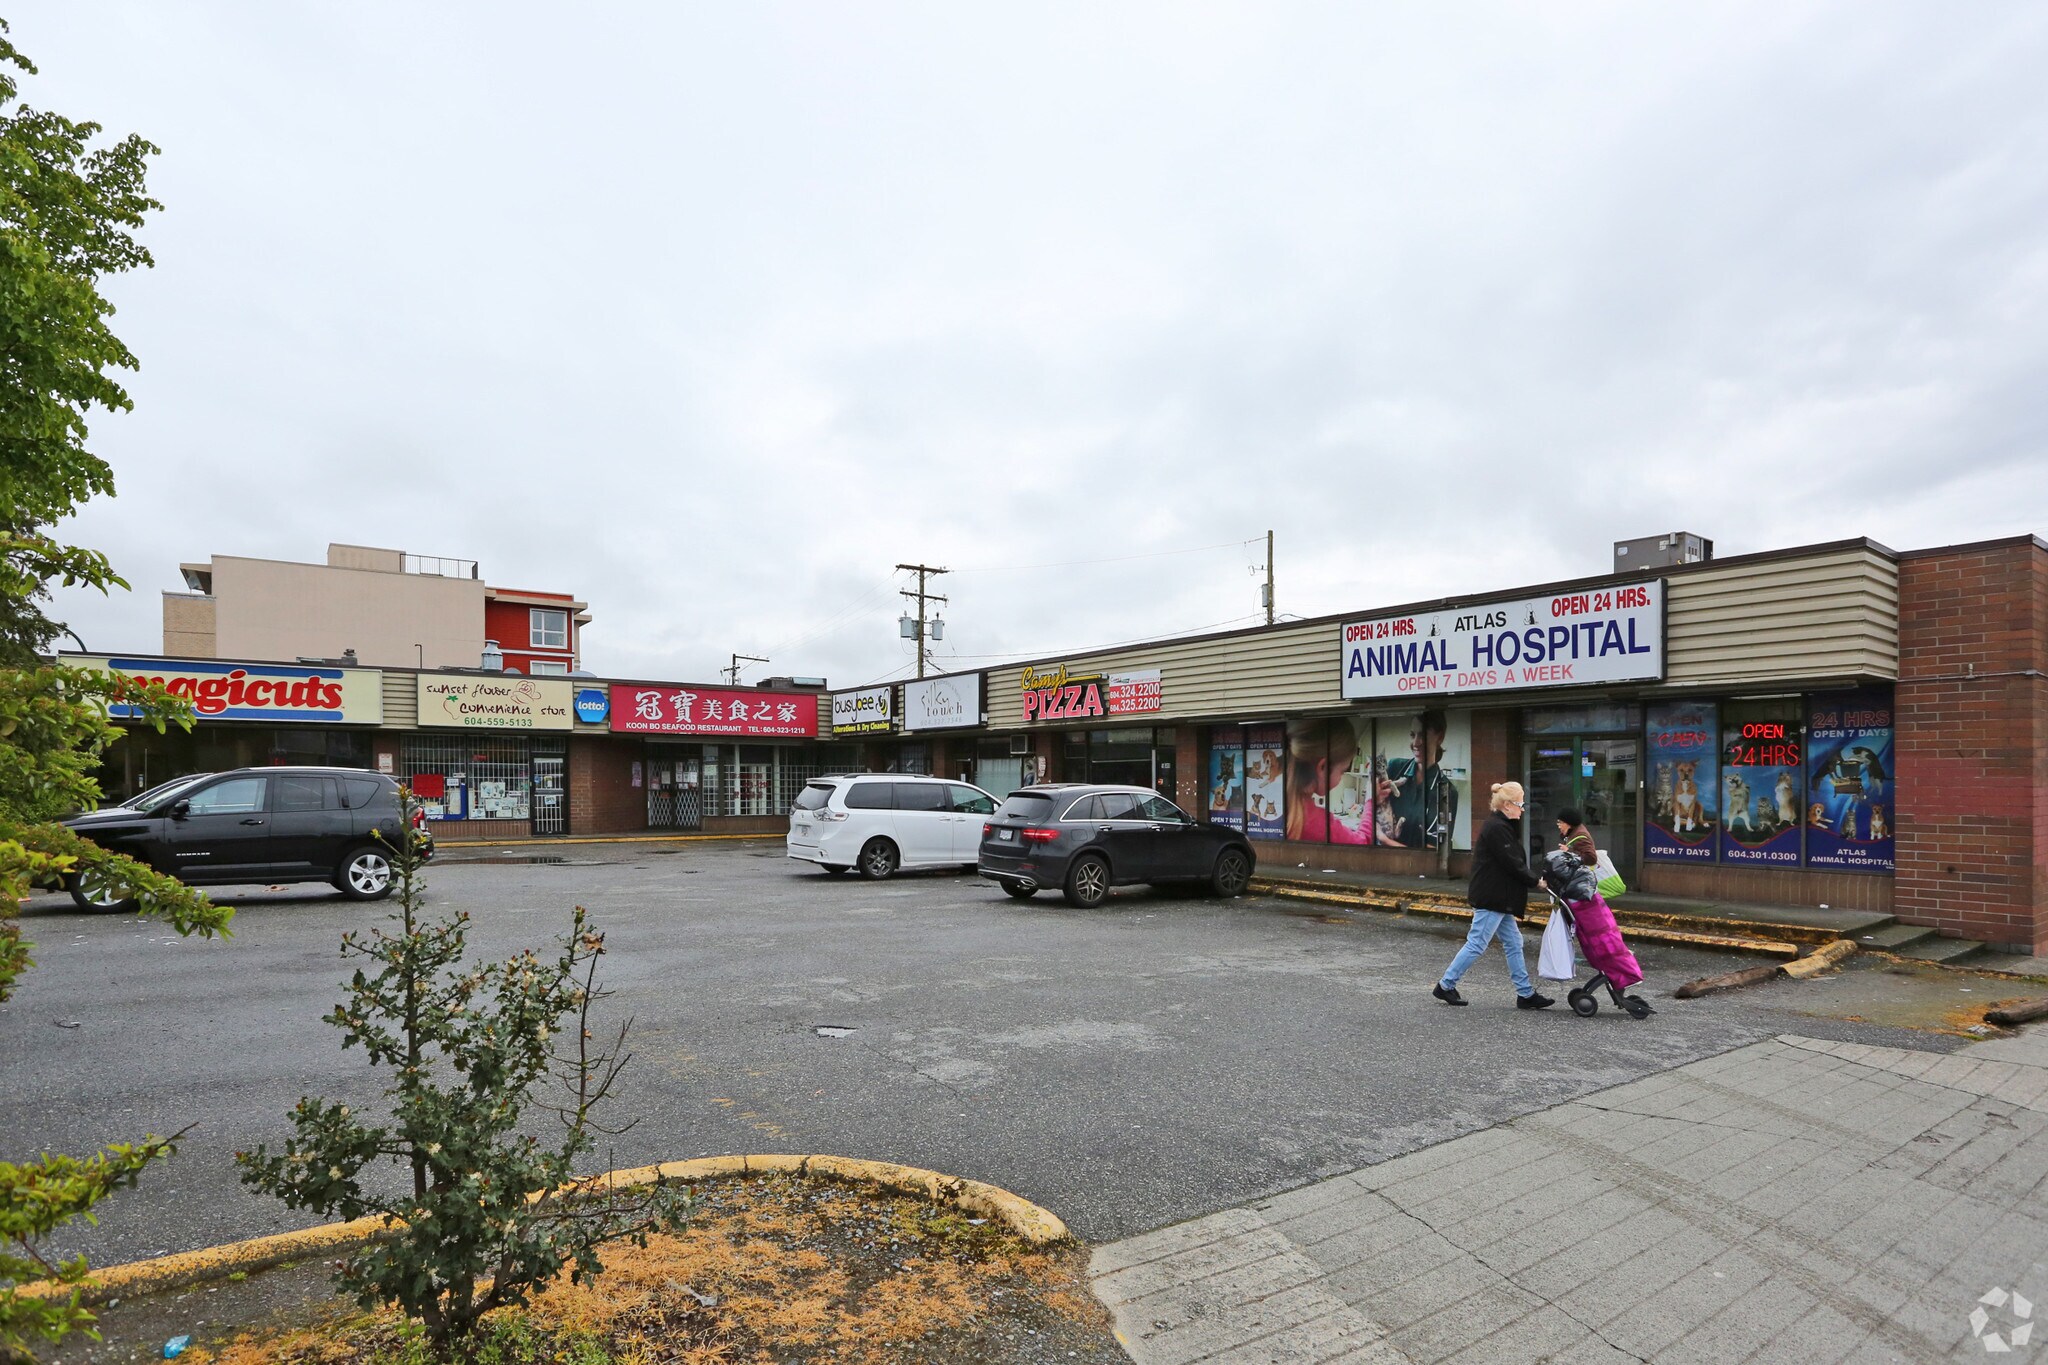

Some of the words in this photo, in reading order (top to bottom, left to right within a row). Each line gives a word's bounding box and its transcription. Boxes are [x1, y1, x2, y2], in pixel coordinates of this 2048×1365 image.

[1551, 594, 1589, 617] OPEN
[1593, 592, 1611, 611] 24
[1616, 586, 1651, 609] HRS.
[1454, 611, 1507, 633] ATLAS
[1346, 623, 1374, 643] OPEN
[1376, 621, 1390, 639] 24
[1392, 618, 1417, 636] HRS.
[1348, 638, 1457, 679] ANIMAL
[1472, 617, 1650, 668] HOSPITAL
[1397, 675, 1437, 692] OPEN
[1442, 674, 1452, 688] 7
[1457, 670, 1497, 688] DAYS
[1504, 669, 1516, 684] A
[1522, 664, 1574, 682] WEEK
[1110, 682, 1160, 698] 604.324.2200
[927, 701, 963, 717] touch
[1022, 683, 1104, 721] PIZZA
[1110, 696, 1160, 712] 604.325.2200
[464, 716, 533, 727] 604-559-5133
[1812, 711, 1838, 728] 24
[1844, 710, 1890, 728] HRS
[626, 722, 648, 730] KOON
[649, 722, 661, 730] BO
[662, 722, 696, 731] SEAFOOD
[697, 724, 742, 733] RESTAURANT
[1743, 723, 1785, 739] OPEN
[1813, 730, 1844, 739] OPEN
[1848, 730, 1854, 738] 7
[1858, 729, 1889, 738] DAYS
[1731, 746, 1756, 768] 24
[1760, 744, 1799, 767] HRS
[1650, 846, 1675, 855] OPEN
[1678, 847, 1684, 855] 7
[1686, 847, 1711, 857] DAYS
[1727, 850, 1797, 861] 604.301.0300
[1837, 848, 1867, 856] ATLAS
[1811, 856, 1845, 864] ANIMAL
[1848, 857, 1895, 866] HOSPITAL
